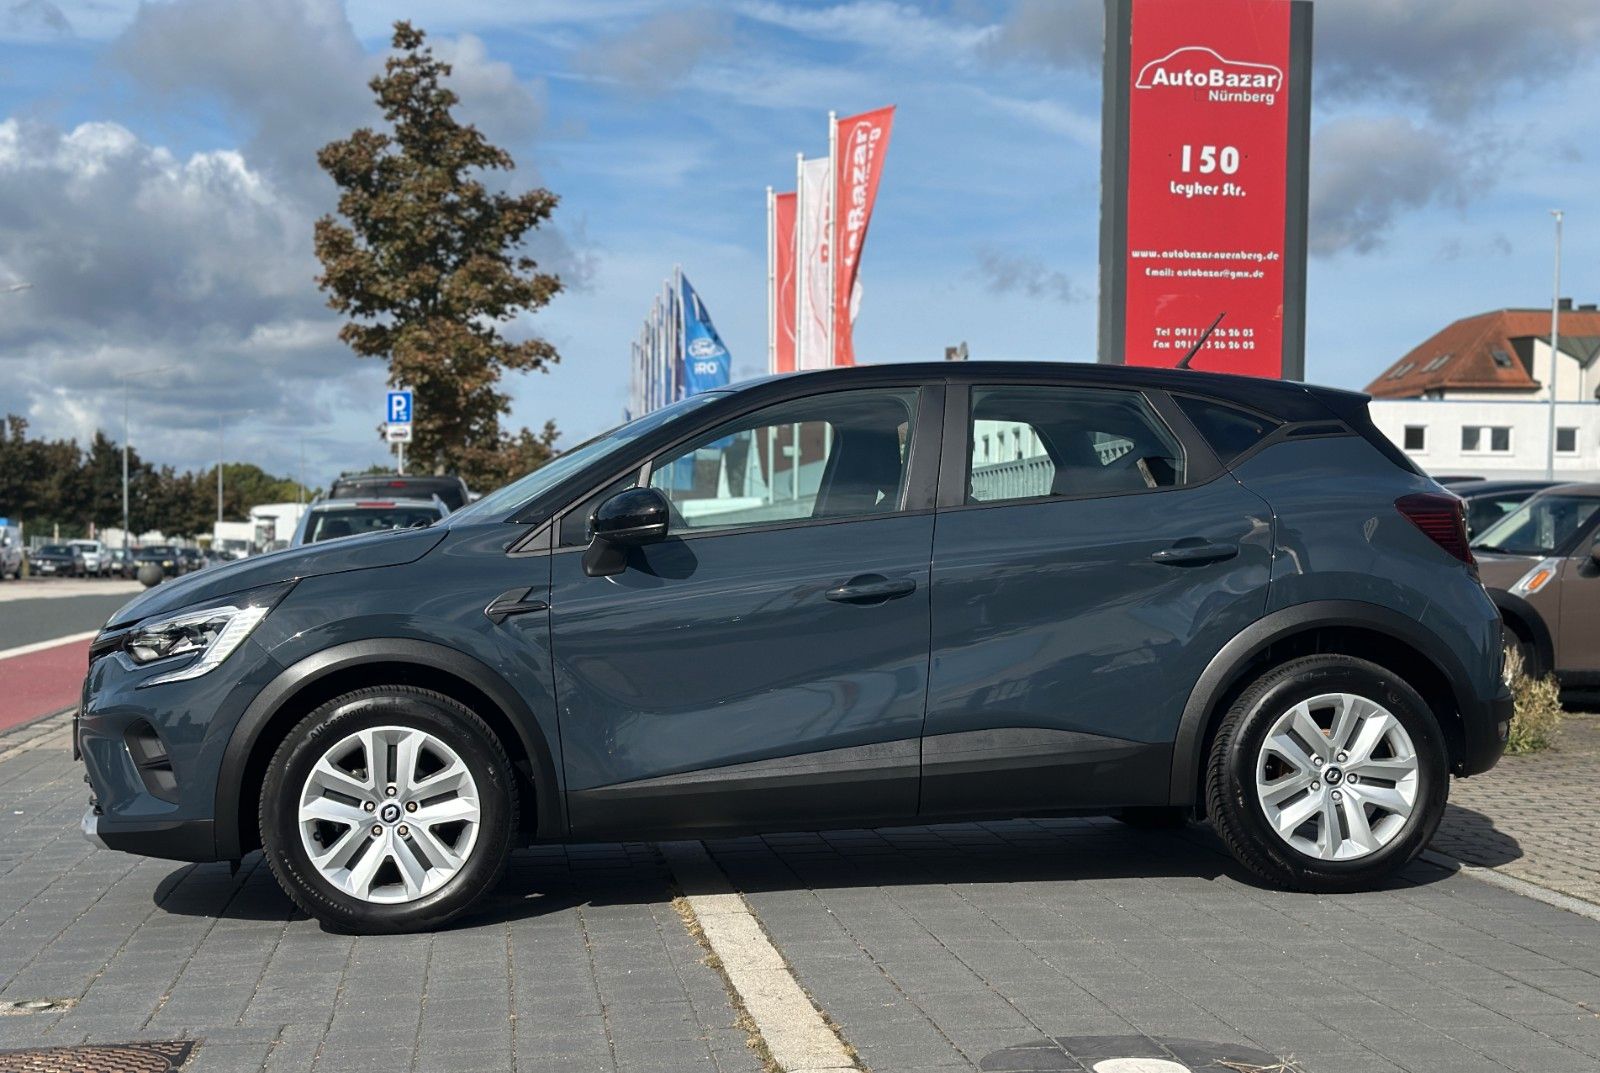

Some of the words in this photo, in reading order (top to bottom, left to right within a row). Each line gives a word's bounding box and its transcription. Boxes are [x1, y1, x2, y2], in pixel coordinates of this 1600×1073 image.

[1152, 68, 1277, 87] AutoBazar
[1208, 90, 1275, 105] Nürnberg
[1182, 145, 1239, 174] 150
[1170, 181, 1219, 198] Leyher
[1222, 182, 1246, 196] Str.
[1176, 268, 1265, 280] autobazar@gmx.de
[1155, 327, 1171, 337] Tel
[1174, 327, 1198, 337] 0911
[1214, 328, 1226, 337] 26
[1228, 328, 1240, 337] 26
[1152, 340, 1170, 349] Fax
[1214, 340, 1226, 349] 26
[1228, 340, 1240, 349] 26
[1242, 340, 1255, 349] 02
[392, 395, 407, 420] P
